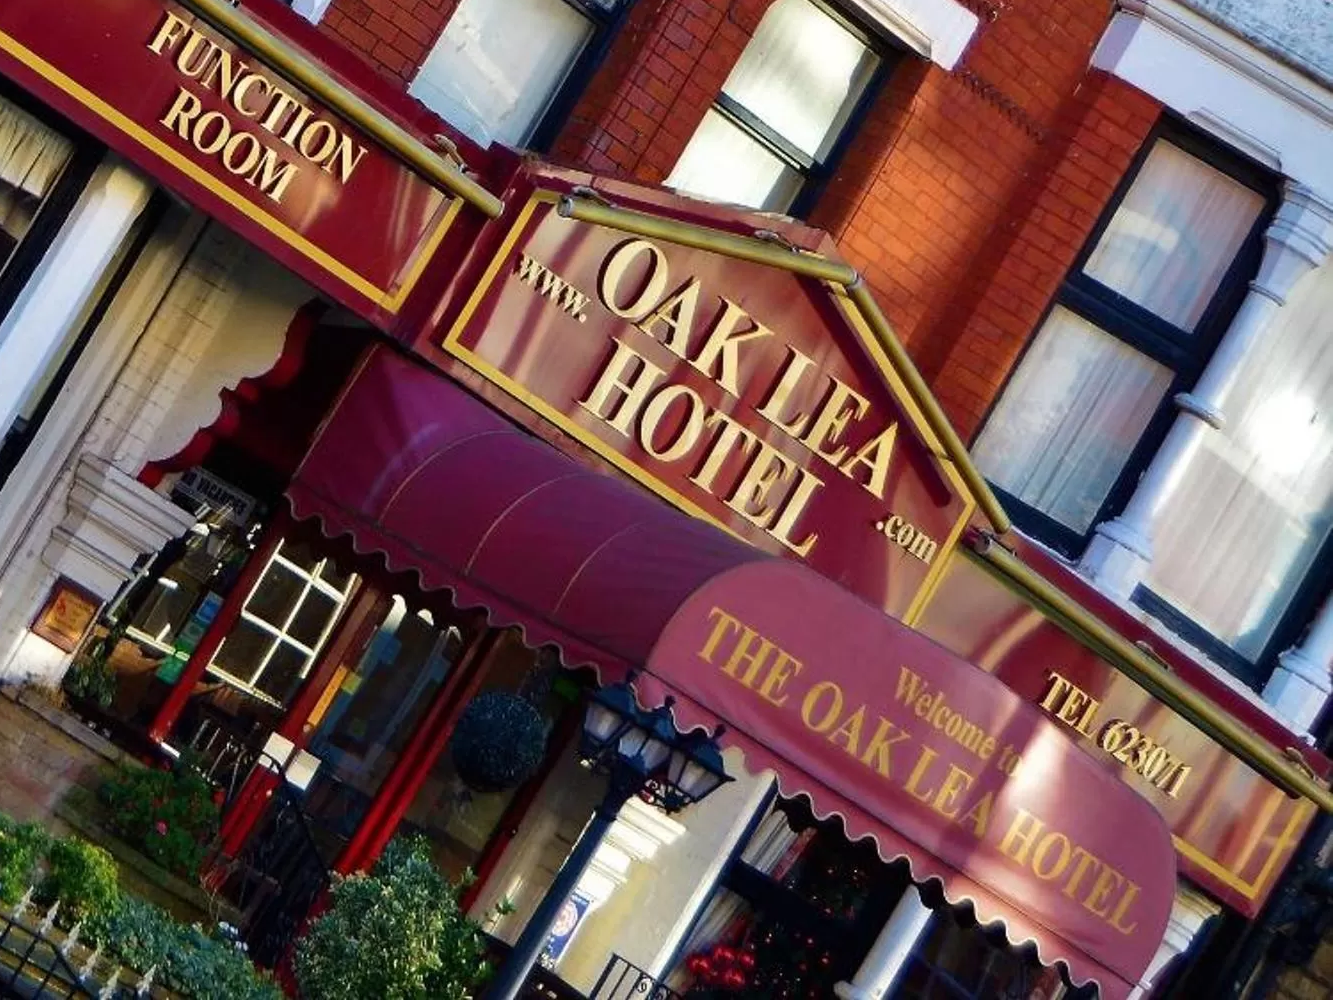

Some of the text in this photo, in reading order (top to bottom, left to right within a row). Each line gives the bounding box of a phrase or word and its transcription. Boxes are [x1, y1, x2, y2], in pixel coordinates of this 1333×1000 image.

[146, 10, 368, 185] FUNCTION
[159, 86, 301, 205] ROOM
[519, 251, 591, 323] www.
[600, 239, 898, 501] OAK LEA
[578, 336, 826, 558] HOTEL
[875, 515, 938, 565] .com
[894, 665, 996, 760] Welcome
[1038, 671, 1100, 739] TEL
[696, 605, 1143, 936] THE OAK LEA HOTEL
